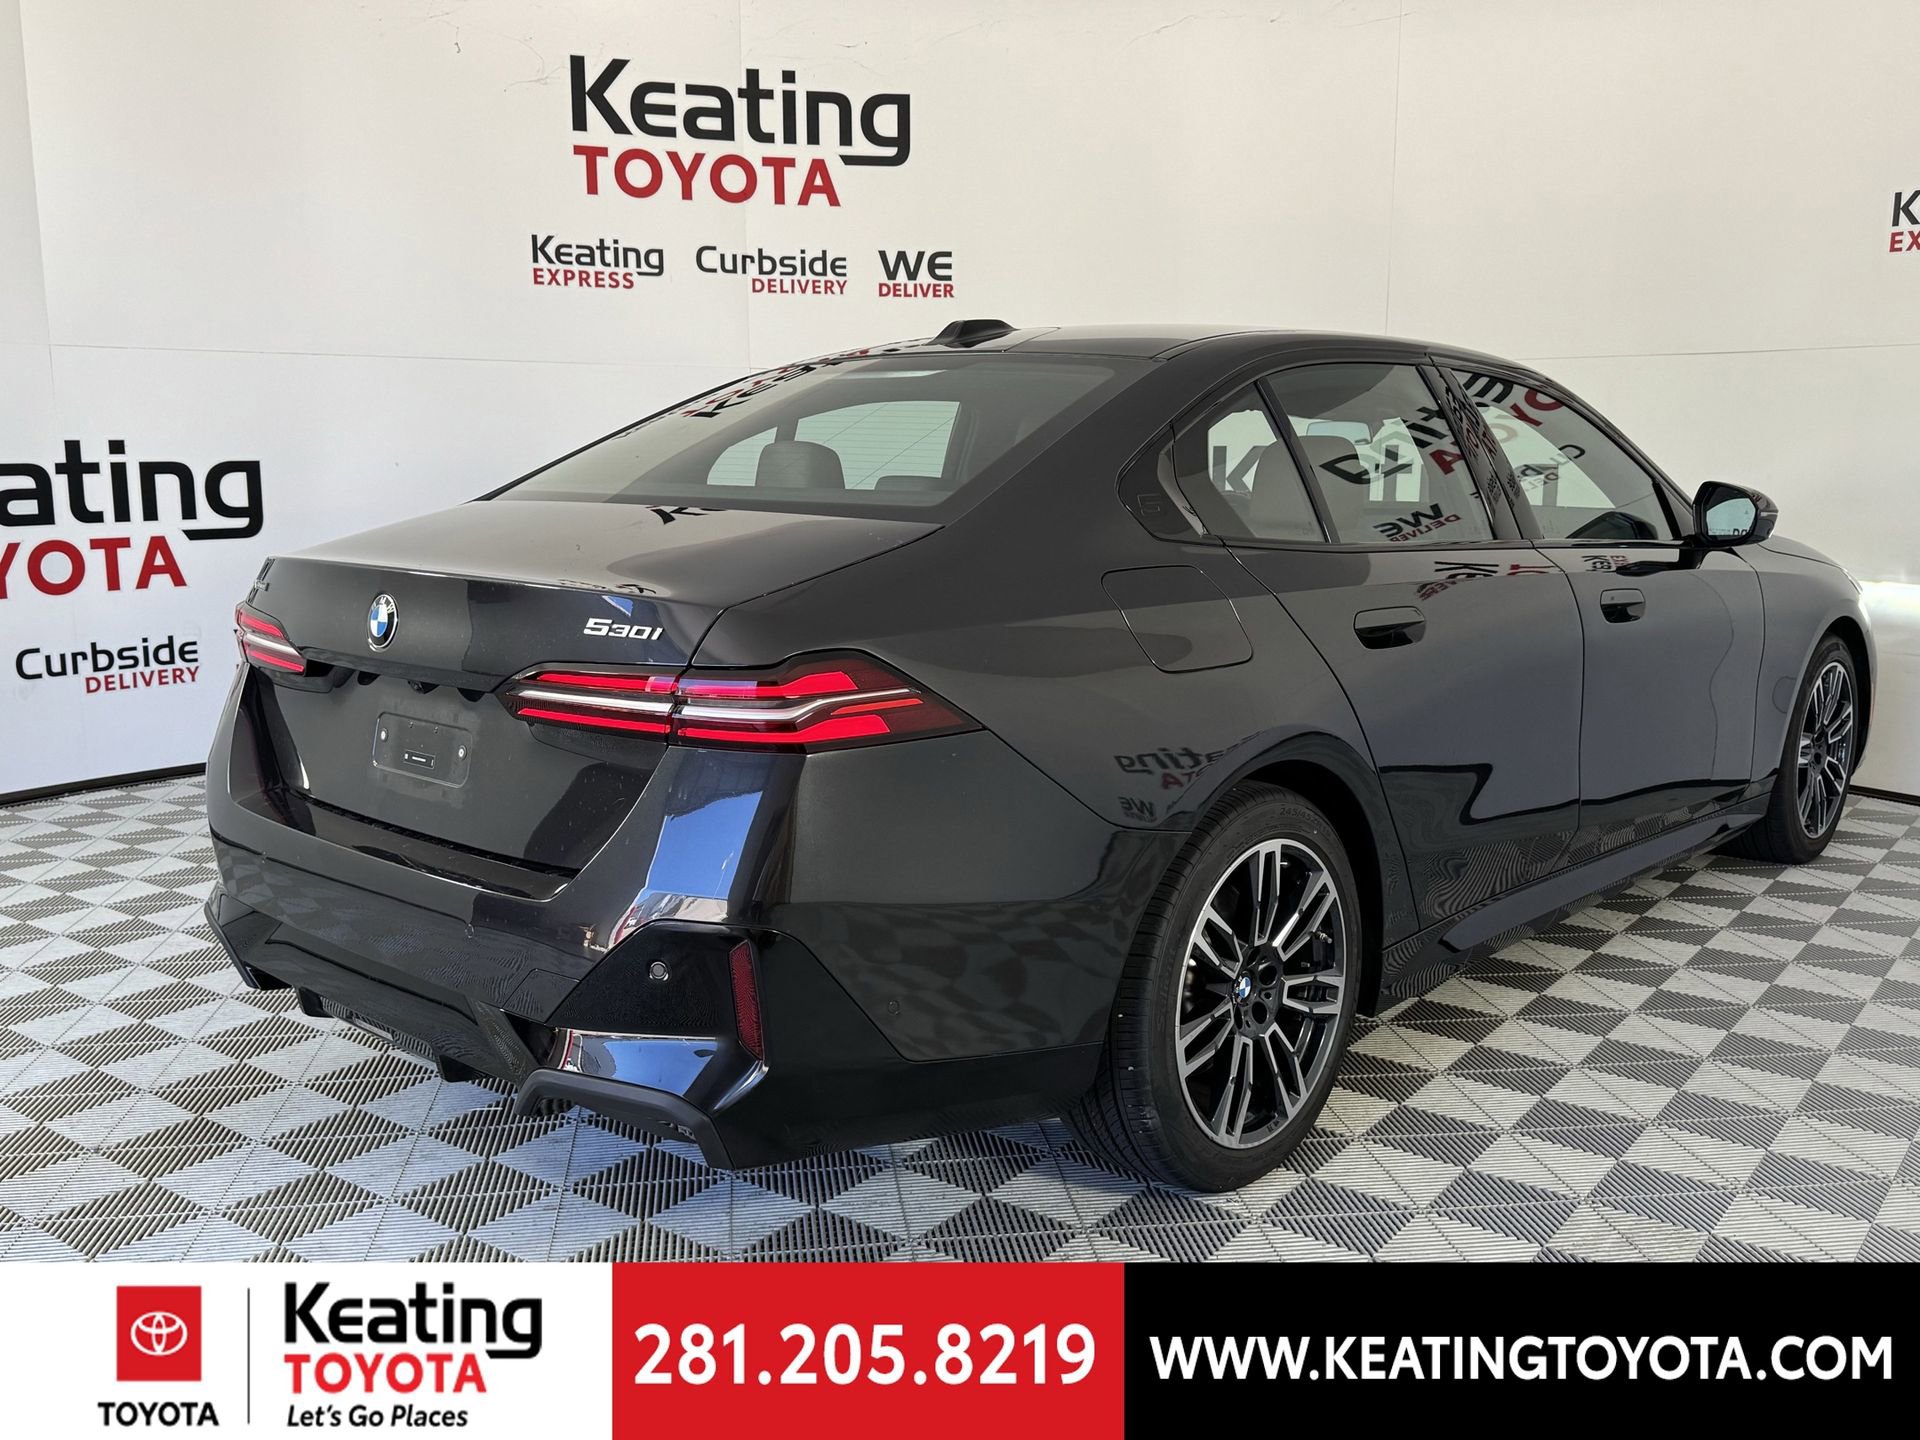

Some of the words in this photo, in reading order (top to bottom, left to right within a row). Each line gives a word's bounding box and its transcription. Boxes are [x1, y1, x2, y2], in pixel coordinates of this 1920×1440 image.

[569, 55, 911, 166] Keating
[573, 145, 841, 207] TOYOTA
[531, 234, 664, 277] Keating
[695, 245, 847, 277] Curbside
[878, 250, 953, 281] WE
[532, 267, 635, 290] EXPRESS
[751, 278, 847, 296] DELIVERY
[878, 282, 955, 299] DELIVER
[15, 635, 199, 680] Curbside
[84, 666, 200, 694] DELIVERY
